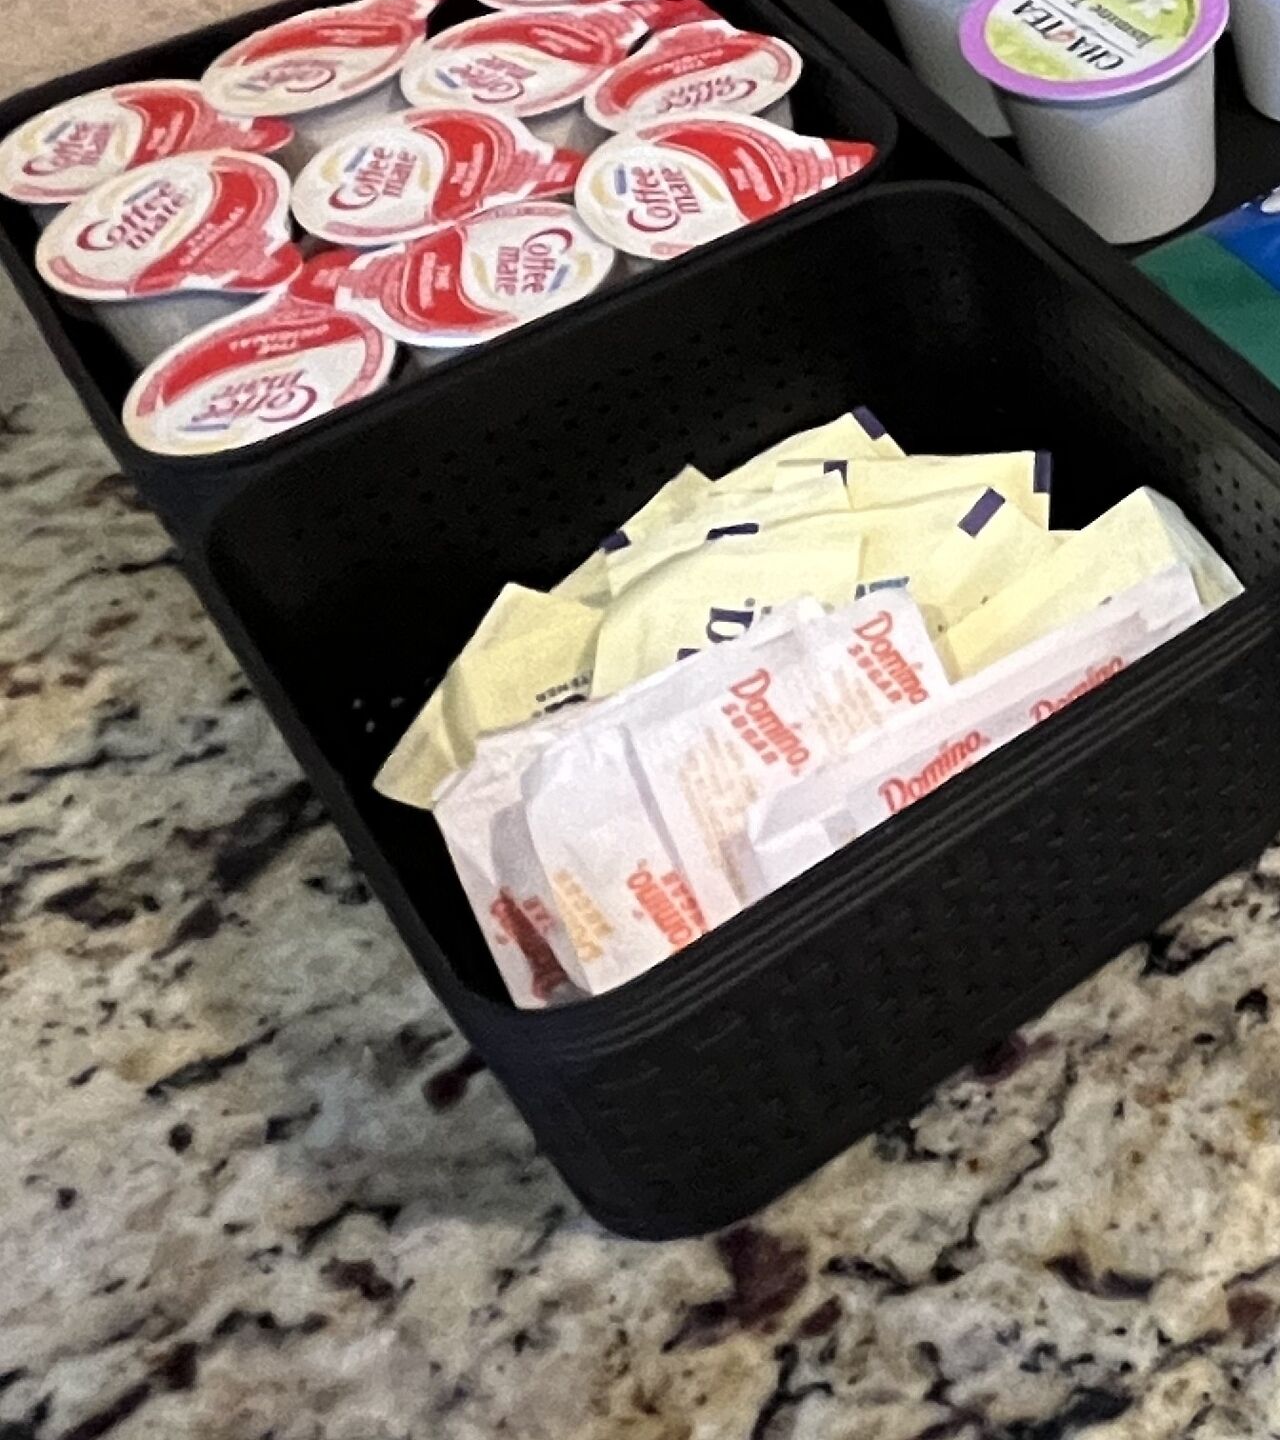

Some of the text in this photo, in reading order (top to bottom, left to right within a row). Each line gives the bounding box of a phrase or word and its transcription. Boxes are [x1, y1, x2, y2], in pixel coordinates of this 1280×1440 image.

[328, 146, 394, 210] Coffee
[382, 150, 418, 199] mate
[627, 166, 682, 233] Coffee
[661, 163, 704, 215] mate
[76, 180, 174, 251] Coffee
[126, 192, 188, 250] mate
[495, 245, 521, 296] mate
[521, 227, 574, 294] Coffee
[847, 643, 902, 703] SUGAR
[853, 609, 929, 705] Domino
[721, 702, 778, 765] SUGAR
[730, 667, 810, 767] Domino
[878, 730, 982, 813] Domino
[627, 869, 693, 952] omino
[660, 869, 709, 935] UGAR
